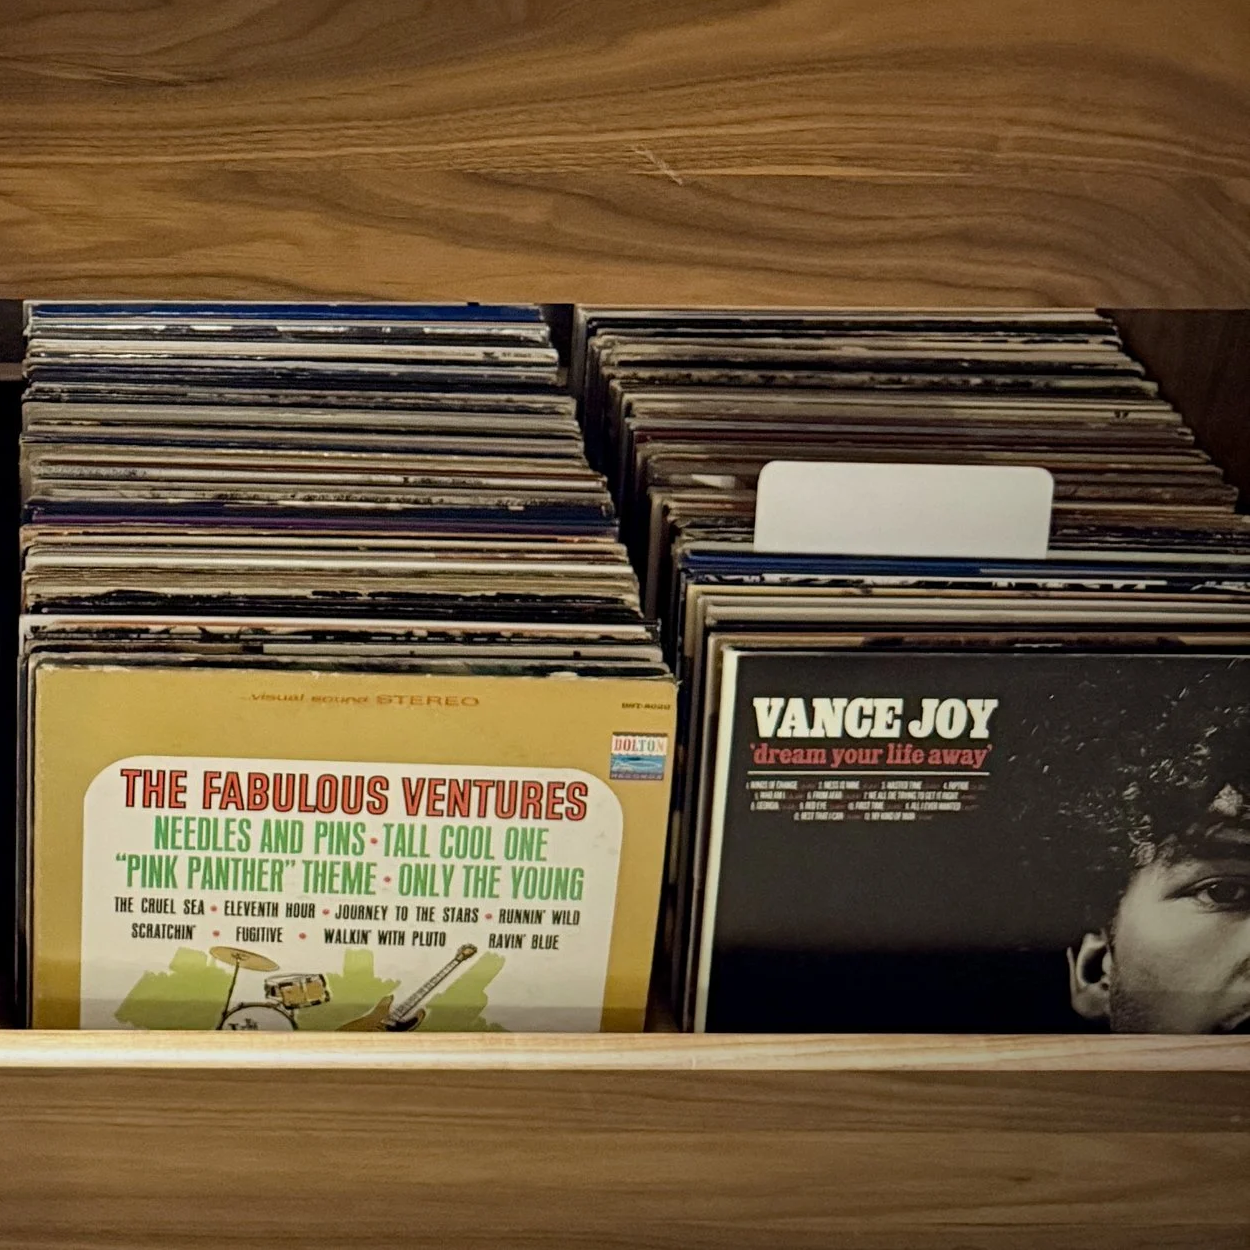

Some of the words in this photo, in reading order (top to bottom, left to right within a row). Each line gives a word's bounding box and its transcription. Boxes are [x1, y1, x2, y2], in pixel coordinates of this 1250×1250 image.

[311, 694, 370, 704] sound
[376, 695, 480, 707] STEREO
[752, 697, 904, 738] VANCE
[907, 697, 999, 739] JOY
[614, 738, 664, 752] DOLTON
[830, 746, 884, 768] your
[886, 743, 924, 765] life
[927, 744, 993, 769] away'
[120, 769, 187, 809] THE
[202, 770, 390, 815] FABULOUS
[401, 777, 589, 821] VENTURES
[154, 815, 252, 853] NEEDLES
[260, 818, 304, 854] AND
[313, 820, 366, 856] PINS
[382, 823, 431, 858] TALL
[439, 824, 495, 860] COOL
[504, 826, 549, 862] ONE
[302, 859, 377, 895] THEME
[398, 863, 455, 898] ONLY
[462, 864, 502, 899] THE
[510, 865, 585, 901] YOUNG
[114, 896, 134, 913] THE
[141, 897, 176, 914] CRUEL
[183, 899, 205, 915] SEA
[224, 900, 279, 918] ELEVENTH
[285, 902, 316, 919] HOUR
[335, 903, 388, 921] JOURNEY
[395, 906, 408, 921] TO
[416, 906, 436, 922] THE
[442, 906, 479, 923] STARS
[499, 908, 546, 924] RUNNIN'
[552, 909, 581, 926] WILD
[131, 923, 197, 940] SCRATCHIN'
[236, 926, 283, 943] FUGITIVE
[324, 928, 372, 945] WALKIN'
[378, 929, 405, 946] WITH
[412, 930, 447, 947] PLUTO
[488, 933, 526, 949] RAVIN'
[531, 934, 560, 950] BLUE
